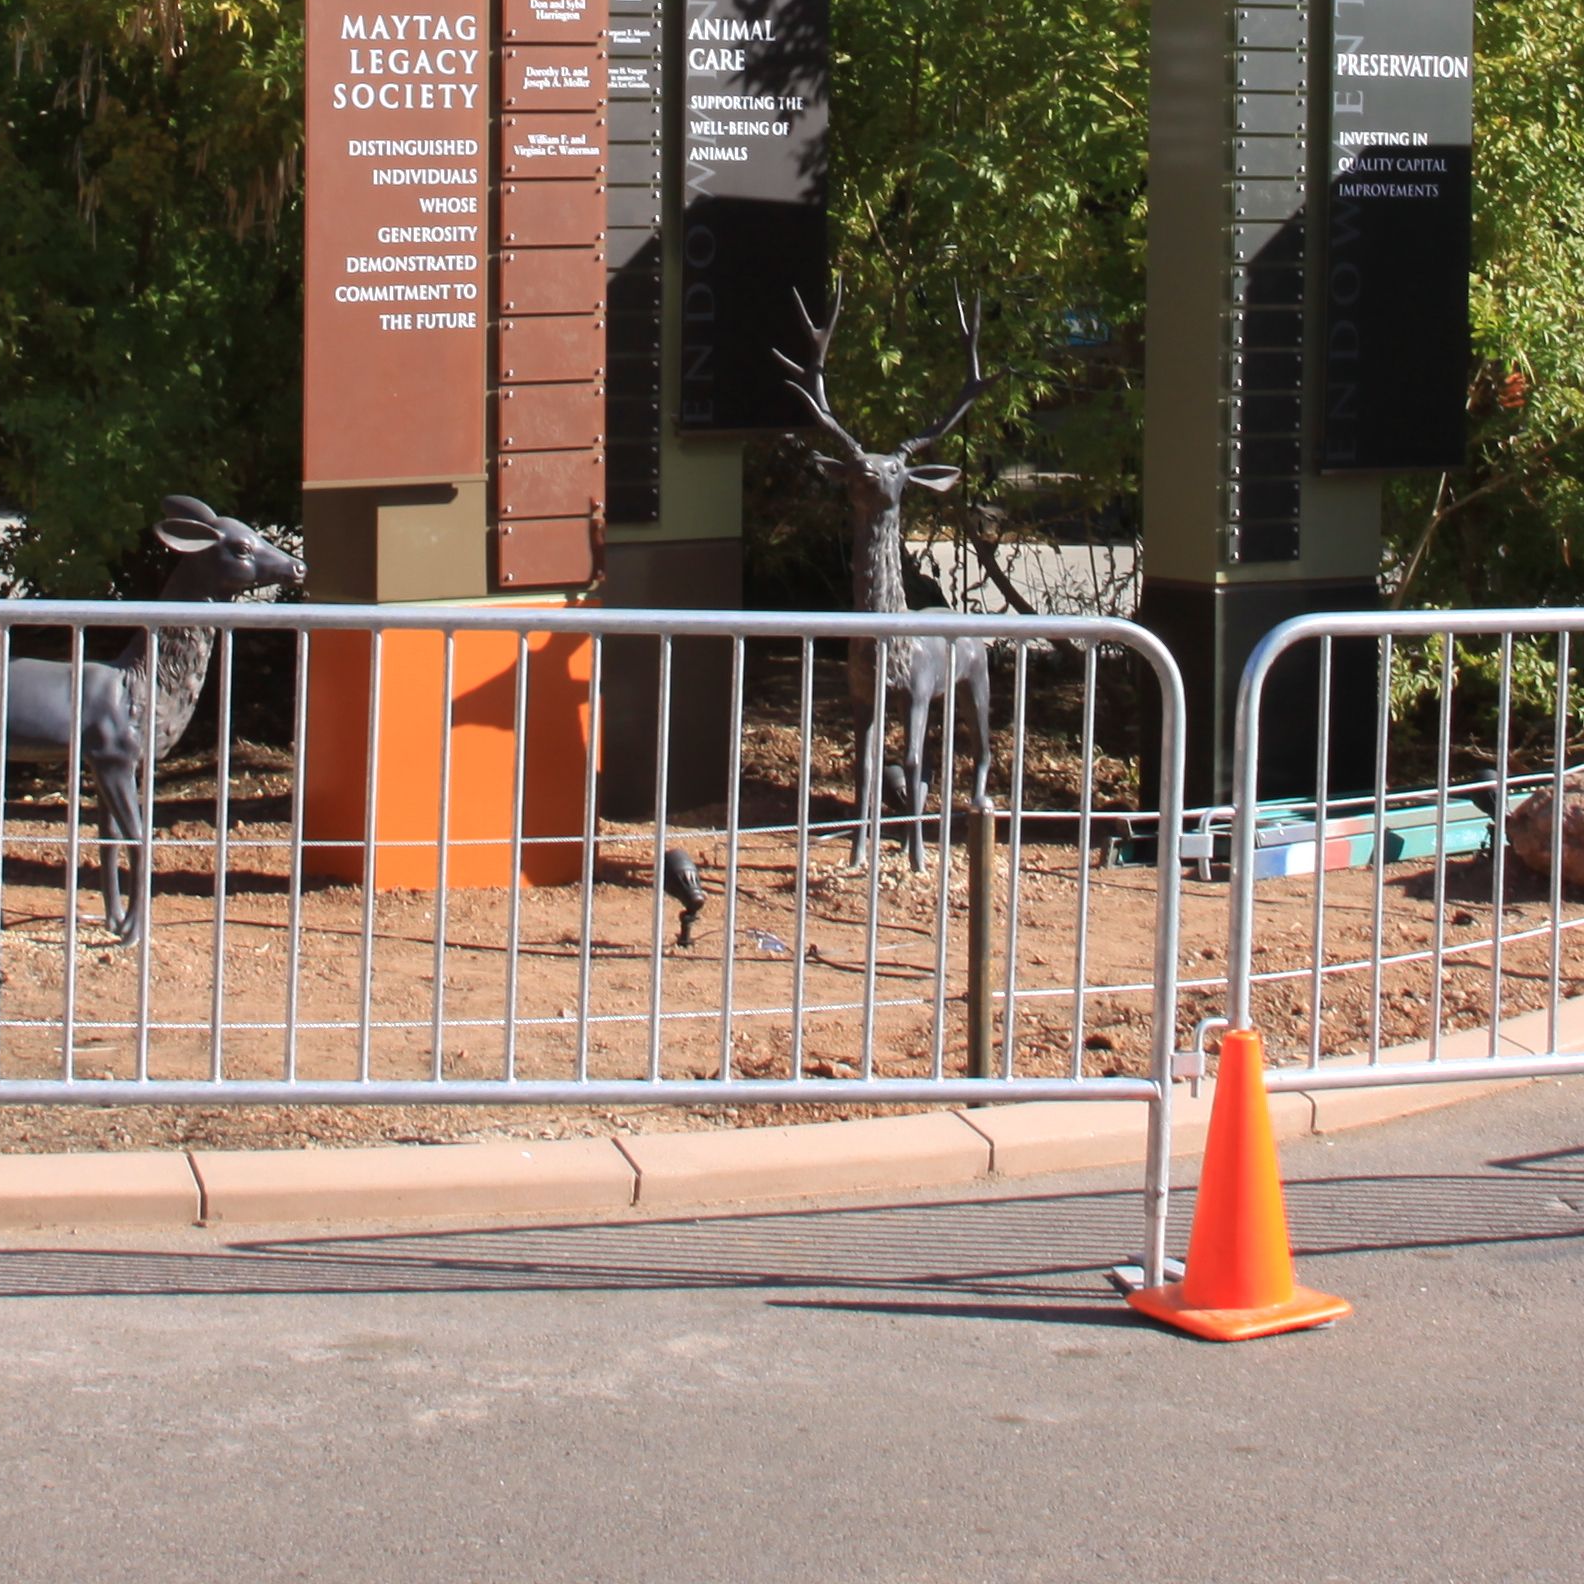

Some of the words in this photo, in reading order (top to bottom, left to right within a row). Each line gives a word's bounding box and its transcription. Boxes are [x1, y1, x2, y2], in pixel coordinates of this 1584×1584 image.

[530, 0, 548, 9] Don
[549, 0, 564, 9] and
[566, 0, 586, 11] Sybil
[536, 10, 580, 22] Harrington
[341, 15, 477, 40] MAYTAG
[688, 18, 776, 41] ANIMAL
[350, 49, 479, 74] LEGACY
[689, 48, 745, 71] CARE
[1337, 53, 1468, 78] PRESERVATION
[526, 66, 559, 78] Dorothy
[561, 66, 571, 77] D.
[572, 66, 588, 77] and
[523, 77, 551, 90] Joseph
[333, 83, 479, 109] SOCIETY
[691, 95, 775, 110] SUPPORTING
[777, 96, 804, 110] THE
[690, 121, 769, 135] WELL-BEING
[772, 122, 790, 135] OF
[528, 134, 559, 144] William
[570, 134, 586, 144] and
[1339, 132, 1409, 146] INVESTING
[1413, 133, 1428, 146] IN
[348, 140, 478, 157] DISTINGUISHED
[514, 145, 546, 157] Virginia
[558, 145, 600, 155] Waterman
[689, 147, 748, 161] ANIMALS
[1338, 157, 1393, 174] QUALITY
[1396, 158, 1447, 172] CAPITAL
[373, 169, 477, 185] INDIVIDUALS
[1339, 183, 1439, 197] IMPROVEMENTS
[419, 198, 477, 214] WHOSE
[378, 226, 478, 243] GENEROSITY
[346, 255, 477, 273] DEMONSTRATED
[335, 284, 451, 302] COMMITMENT
[454, 284, 477, 300] TO
[380, 314, 412, 330] THE
[416, 312, 476, 329] FUTURE
